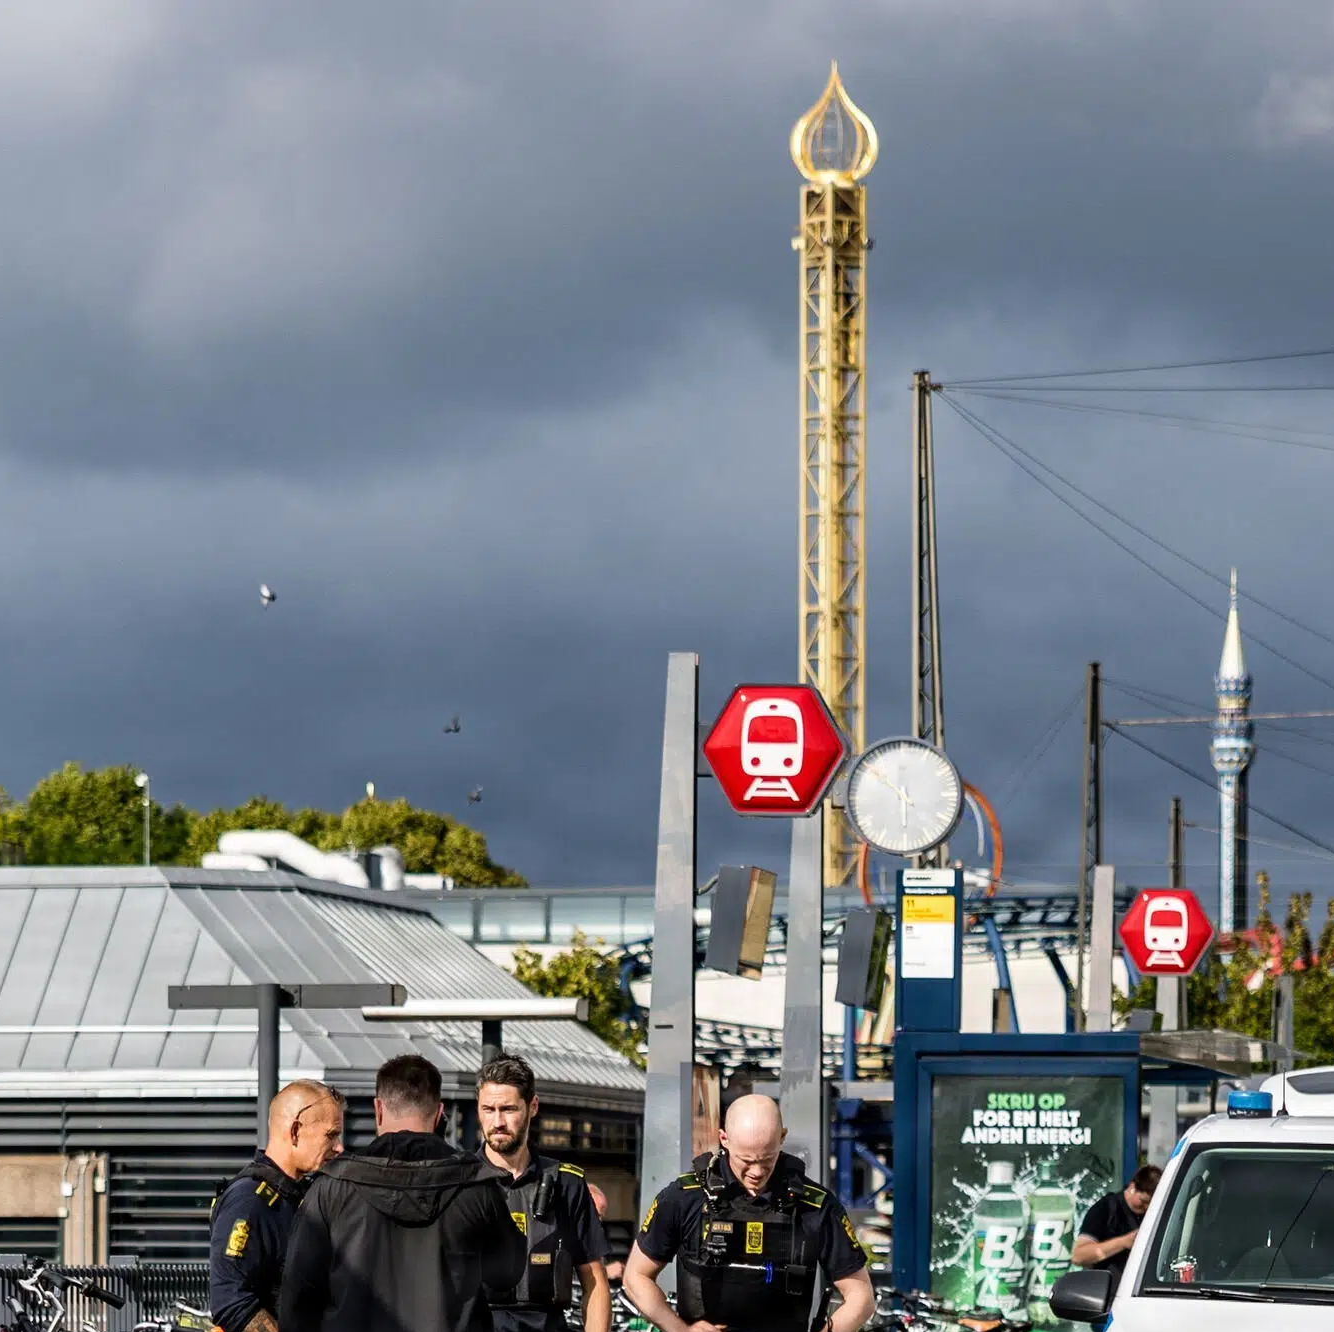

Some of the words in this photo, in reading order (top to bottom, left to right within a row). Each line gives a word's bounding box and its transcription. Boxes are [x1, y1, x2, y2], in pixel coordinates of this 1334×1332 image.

[987, 1093, 1035, 1110] SKRU
[1038, 1093, 1066, 1110] OP
[973, 1109, 1011, 1127] FOR
[1012, 1110, 1037, 1128] EN
[1038, 1110, 1080, 1128] HELT
[961, 1126, 1024, 1144] ANDEN
[1026, 1127, 1092, 1145] ENERGI
